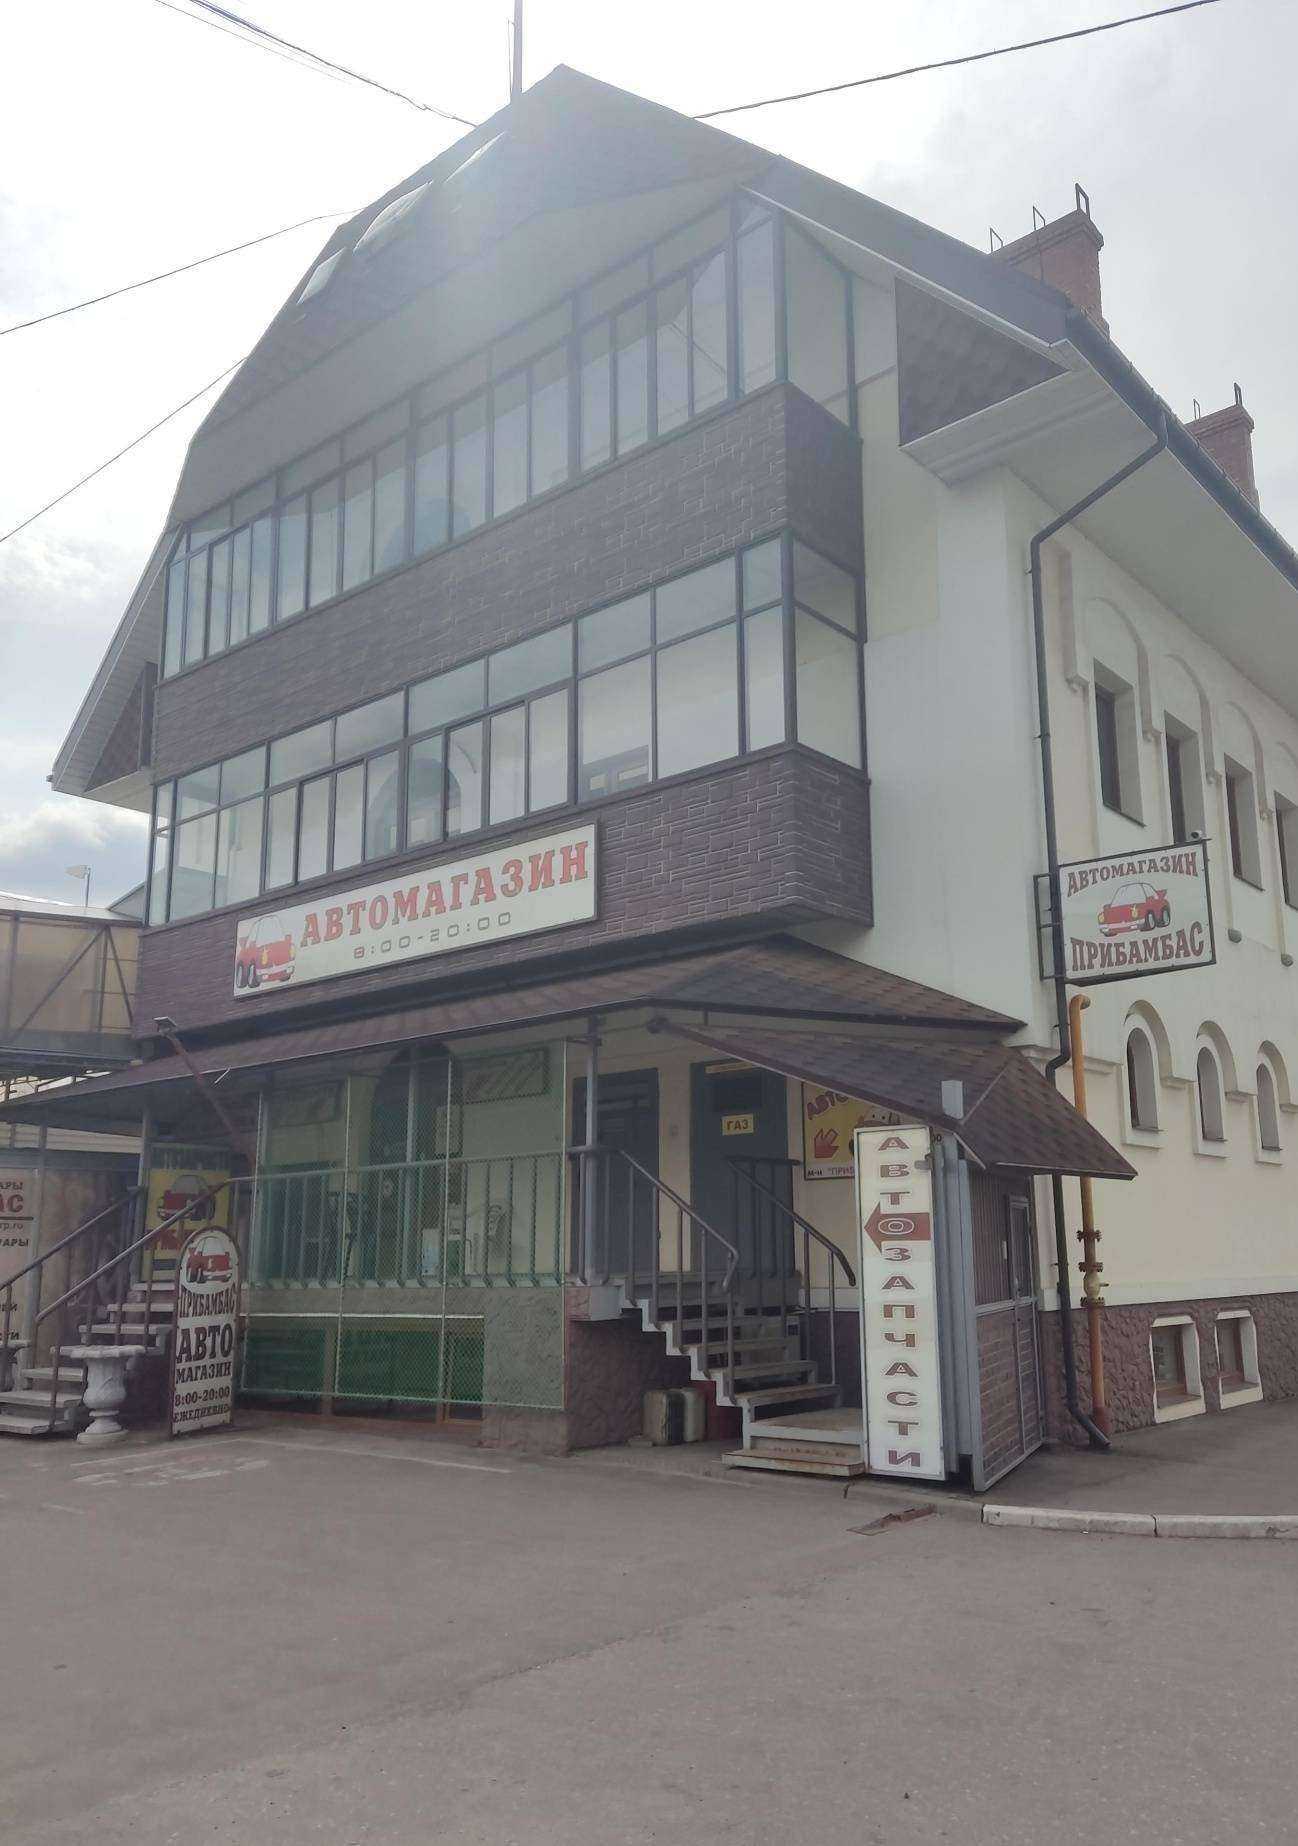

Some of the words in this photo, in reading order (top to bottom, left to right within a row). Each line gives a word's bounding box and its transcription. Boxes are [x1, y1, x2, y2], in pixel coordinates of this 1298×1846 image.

[300, 840, 589, 947] АВТОМАГАЗИН
[1067, 851, 1199, 897] АВТОМАГАЗИН
[354, 911, 512, 958] 8:00-20:00
[1070, 921, 1204, 972] ПРИБАМБАС
[726, 1118, 749, 1131] ГАЗ
[179, 1282, 236, 1318] ПРИБАМБАС
[877, 1136, 922, 1468] АВТОЗАПЧАСТИ
[177, 1323, 233, 1364] АВТО
[175, 1361, 231, 1384] МАГАЗИН
[175, 1385, 230, 1406] 8:00-20:00
